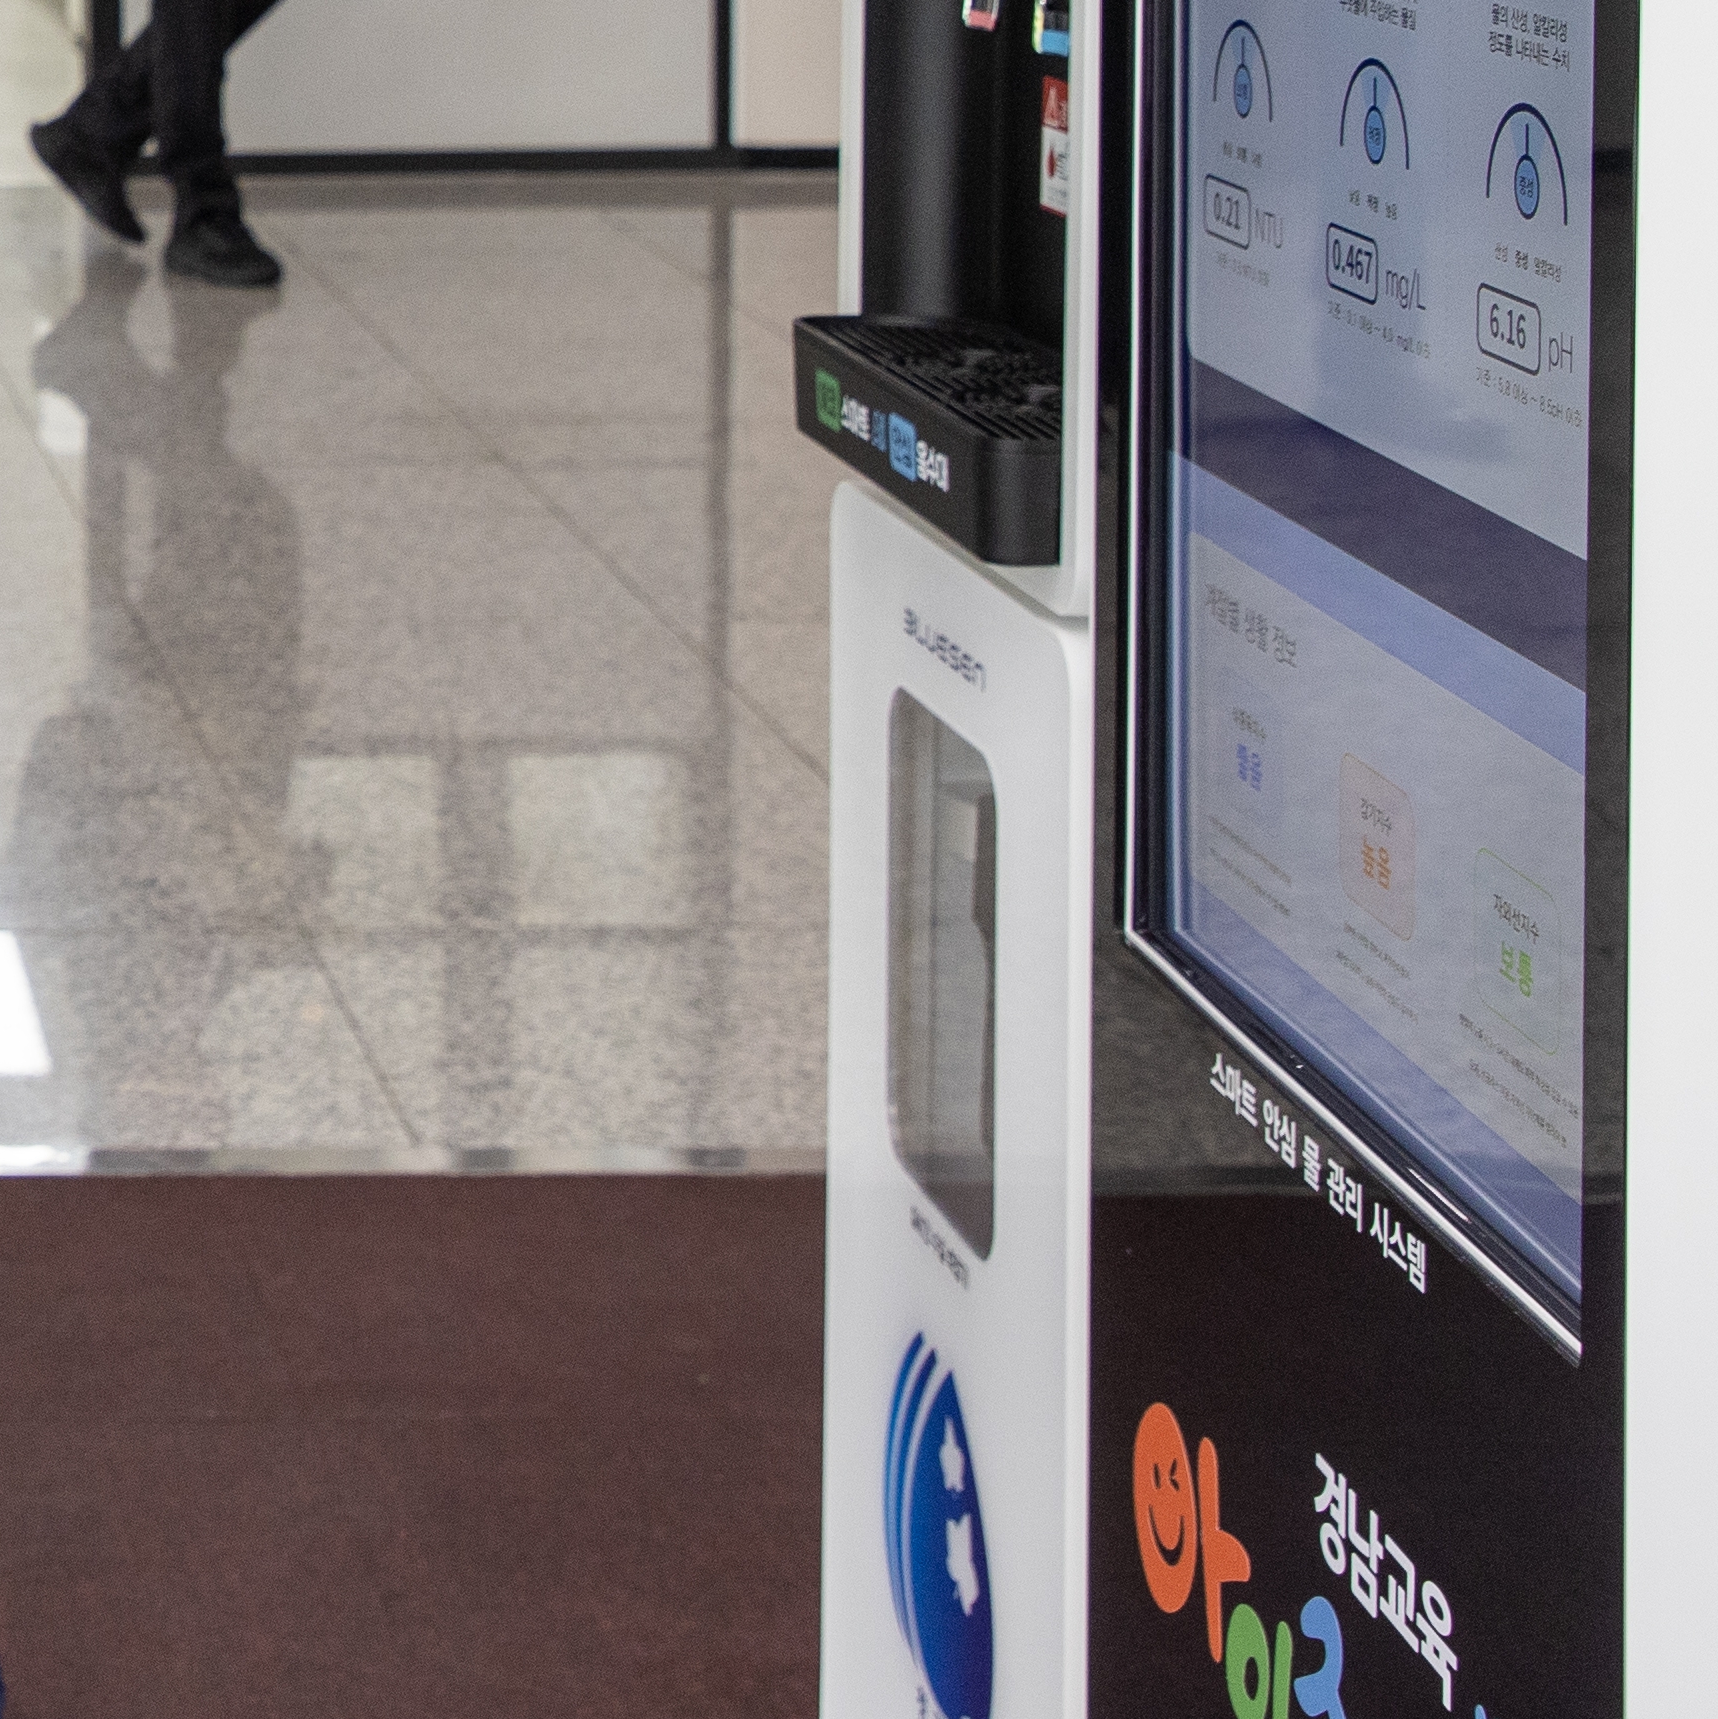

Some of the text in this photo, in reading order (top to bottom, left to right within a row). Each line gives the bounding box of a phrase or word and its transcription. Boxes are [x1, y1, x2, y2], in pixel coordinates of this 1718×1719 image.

[1516, 38, 1549, 66] 나타내는
[1552, 47, 1570, 72] 수치
[1213, 192, 1283, 249] 0.21 NTU
[1332, 238, 1426, 310] 0.467 mg/L
[1489, 303, 1573, 374] 6.16 pH
[1272, 625, 1297, 669] 정보
[1493, 893, 1540, 944] 자외선지수
[1501, 940, 1534, 998] 보통
[1210, 1052, 1427, 1295] 스마트 안심 물 관리 시스템
[1314, 1452, 1459, 1712] 경남교육
